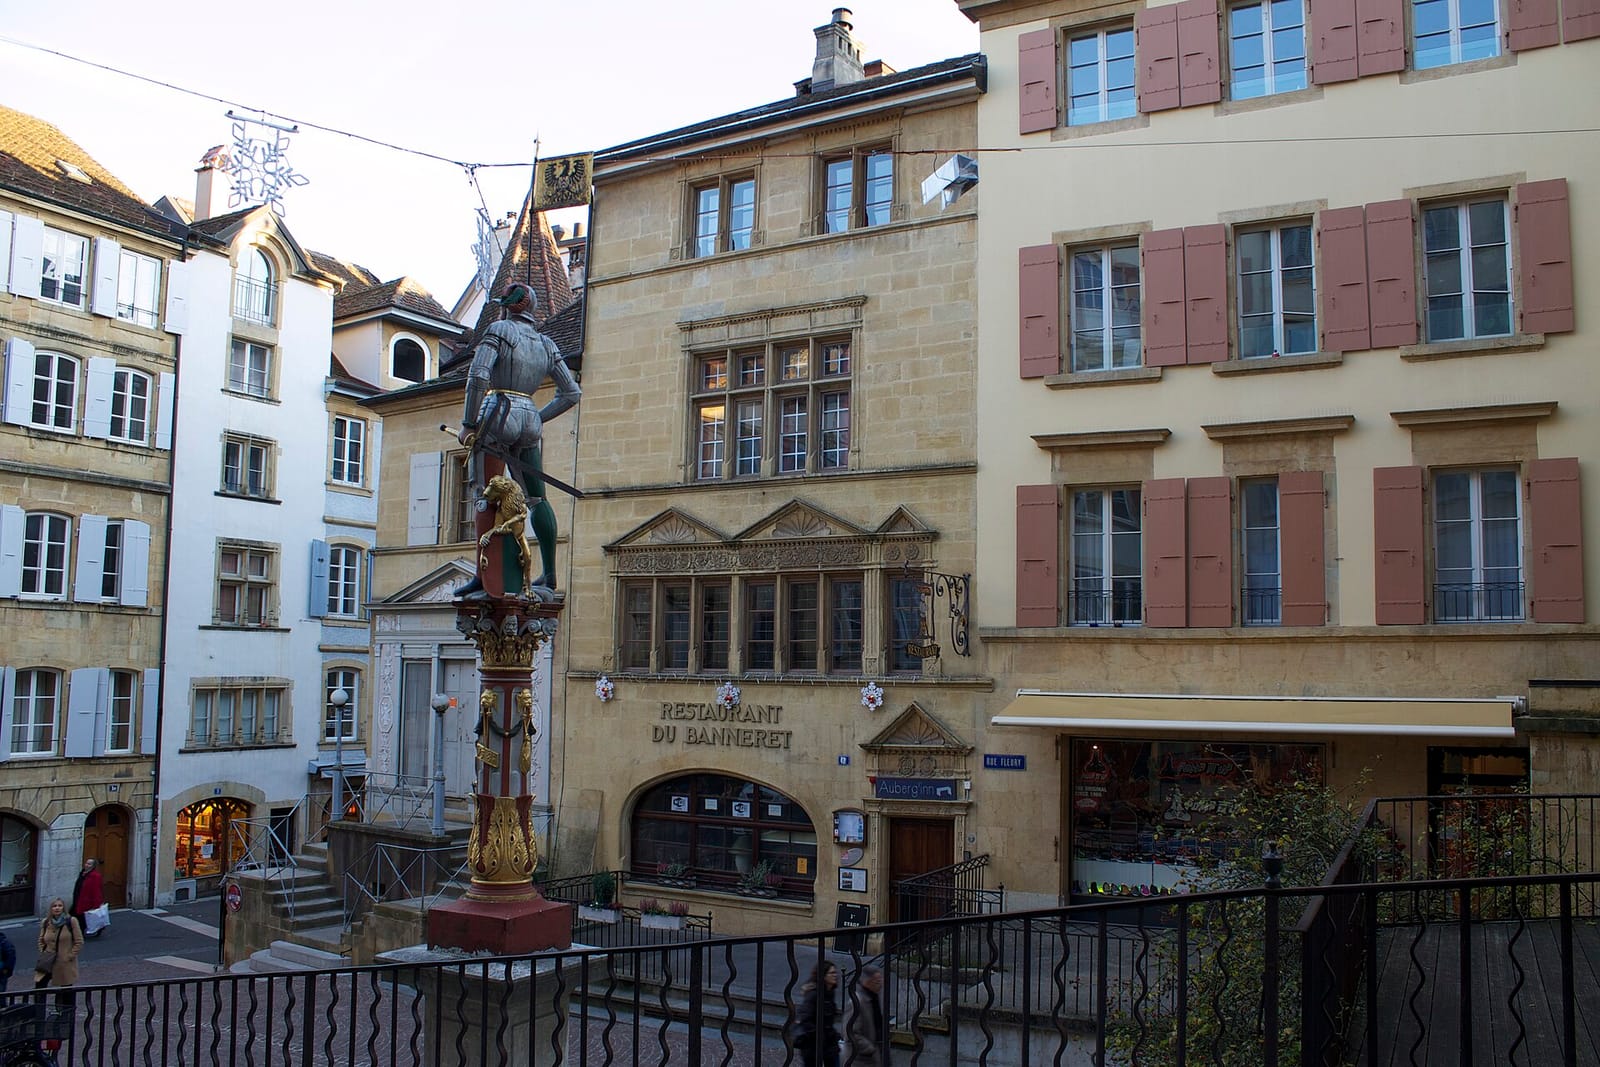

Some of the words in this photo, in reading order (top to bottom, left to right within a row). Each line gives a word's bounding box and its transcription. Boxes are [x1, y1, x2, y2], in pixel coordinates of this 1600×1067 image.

[660, 702, 783, 724] RESTAURANT
[652, 725, 677, 743] DU
[685, 726, 793, 749] BANNERET
[986, 757, 997, 767] RUE
[1001, 758, 1022, 768] FLEURY
